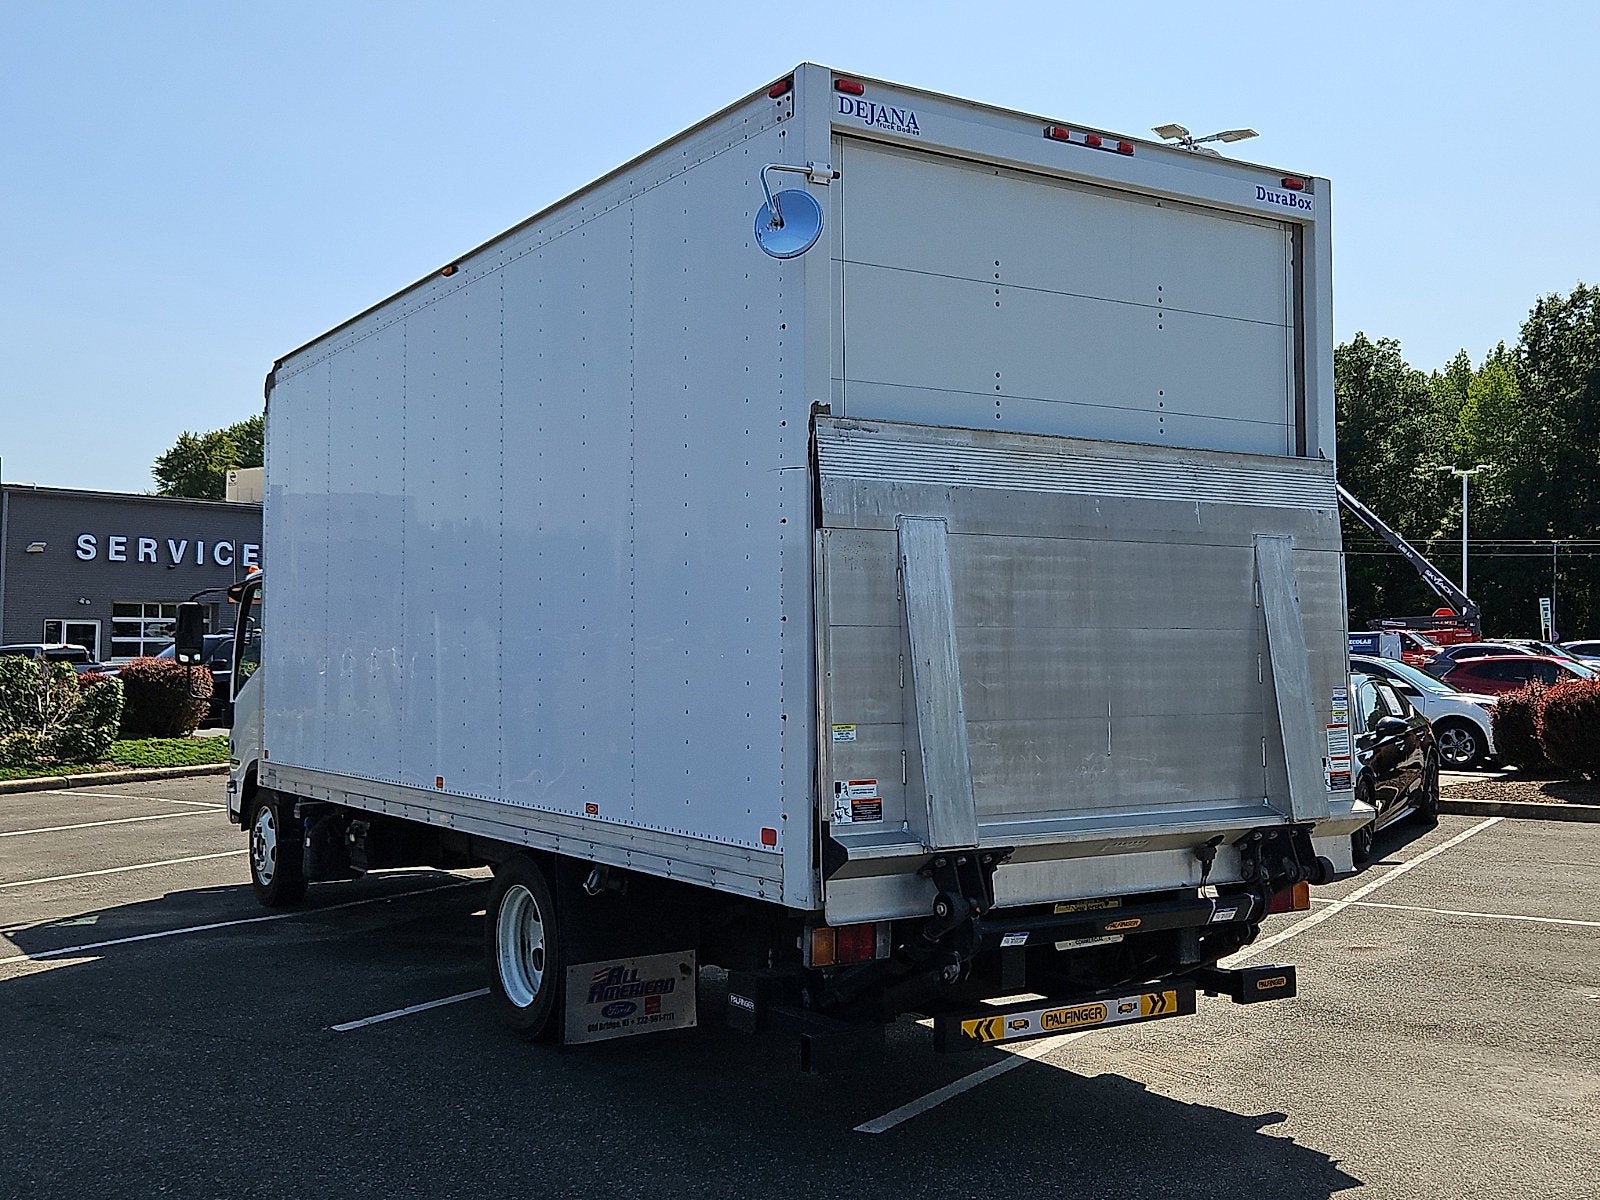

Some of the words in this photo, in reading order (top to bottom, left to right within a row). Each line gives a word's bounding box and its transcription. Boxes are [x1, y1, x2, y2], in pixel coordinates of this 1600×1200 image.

[838, 96, 920, 130] DEJANA
[876, 121, 896, 131] Truck
[896, 125, 920, 136] Bodies
[1256, 185, 1312, 211] DuraBox
[76, 533, 260, 567] SERVICE
[1424, 569, 1454, 597] SKYJACK
[1258, 978, 1285, 988] PALFINGER
[607, 1003, 633, 1016] Ford
[731, 994, 755, 1010] PALFINGER
[1045, 1006, 1103, 1028] PALFINGER
